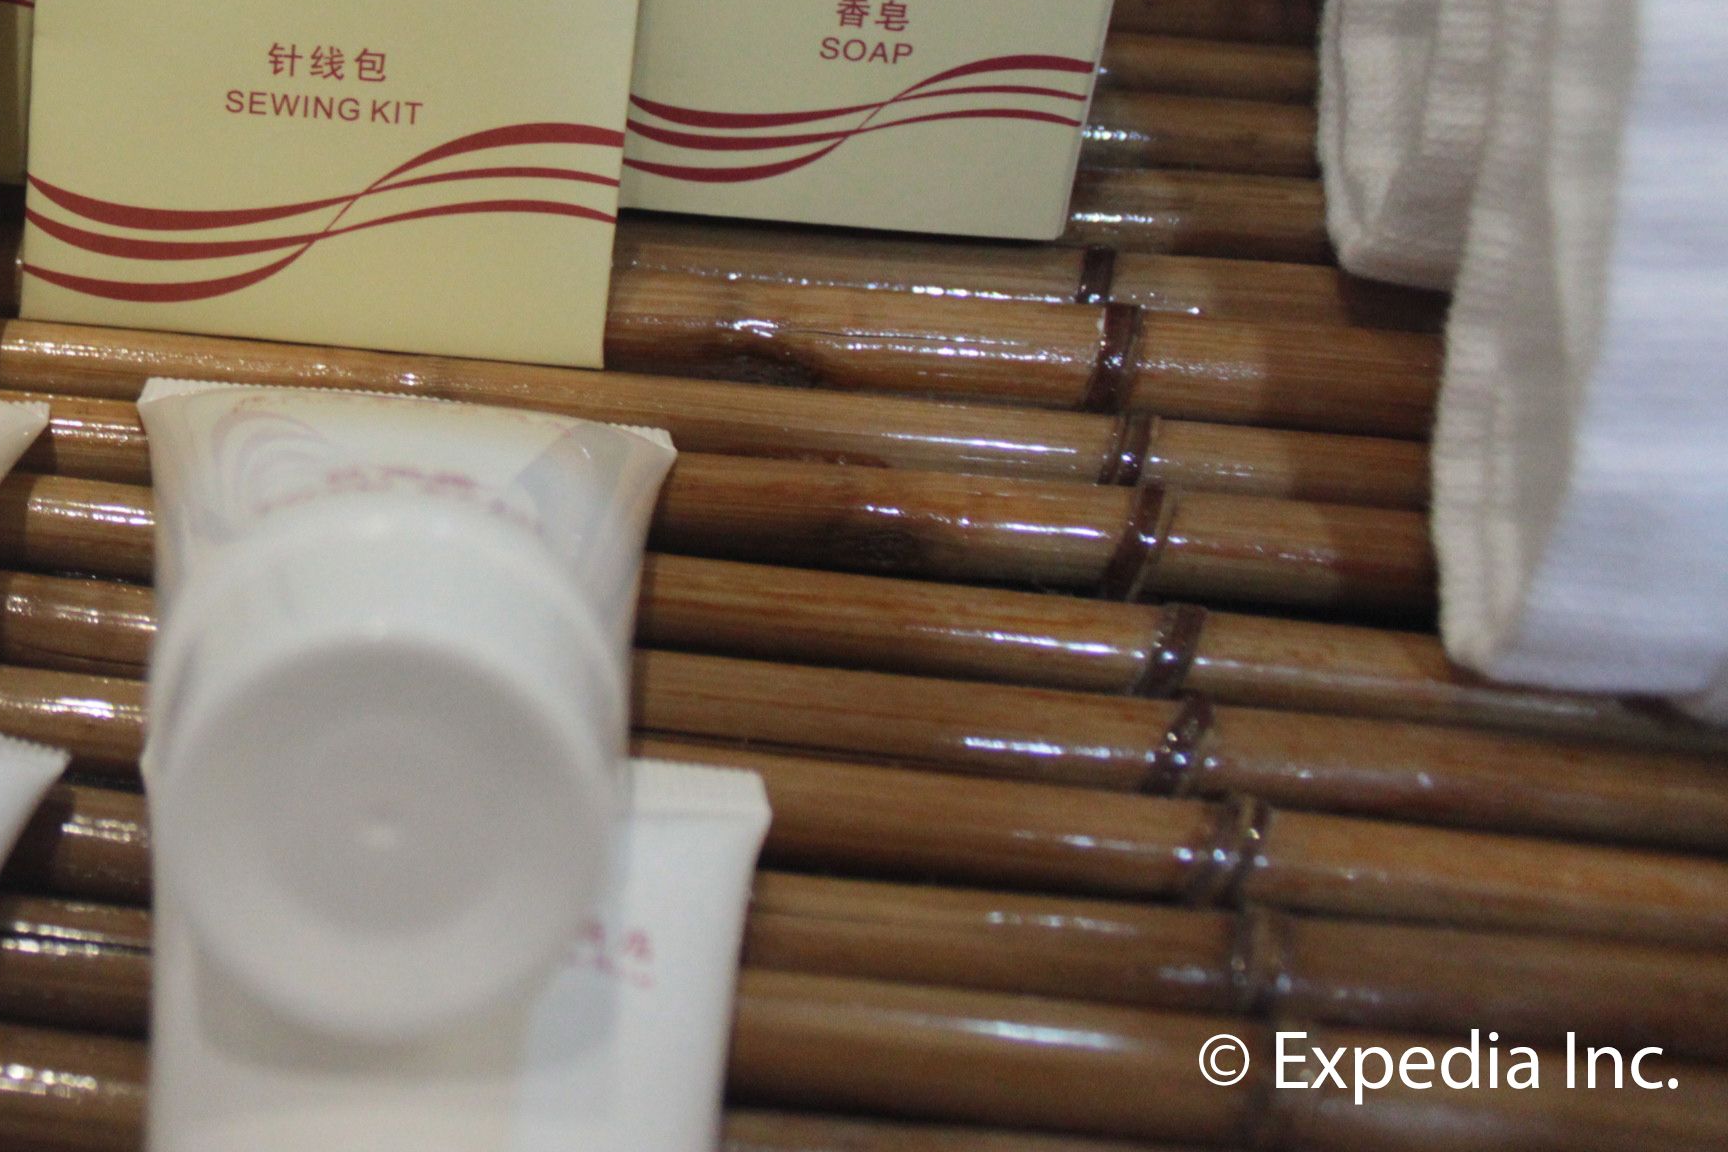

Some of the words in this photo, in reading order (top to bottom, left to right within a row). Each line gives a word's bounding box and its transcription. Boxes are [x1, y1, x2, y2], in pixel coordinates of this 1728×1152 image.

[267, 42, 387, 83] 针线包
[819, 36, 914, 64] SOAP
[225, 89, 361, 122] SEWING
[370, 99, 424, 125] KIT
